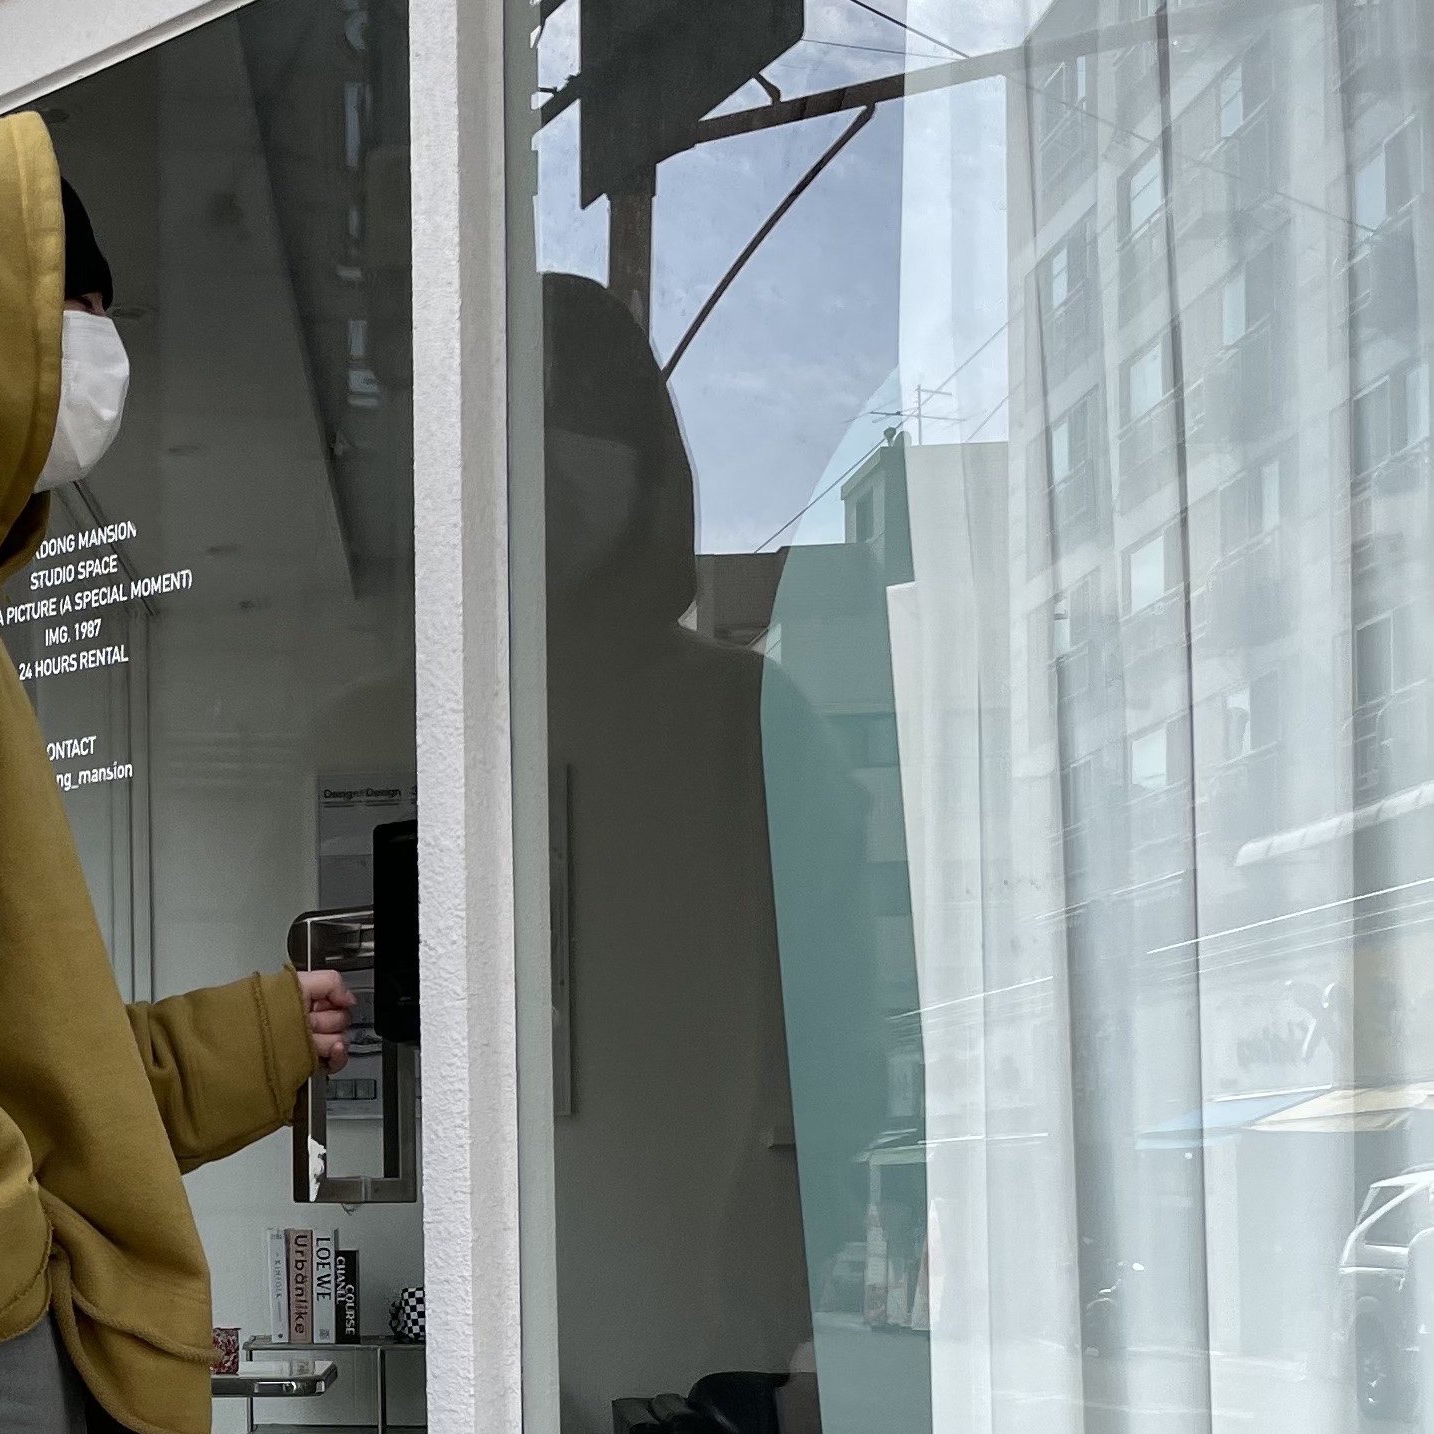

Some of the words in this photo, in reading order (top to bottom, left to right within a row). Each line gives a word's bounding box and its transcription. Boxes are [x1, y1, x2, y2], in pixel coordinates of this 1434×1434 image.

[78, 520, 137, 550] MANSION
[30, 564, 75, 590] STUDIO
[77, 554, 118, 580] SPACE
[6, 597, 57, 625] PICTURE
[59, 594, 73, 616] (A
[74, 583, 128, 610] SPECIAL
[130, 569, 193, 599] MOMENT)
[45, 625, 71, 646] IMG.
[74, 618, 102, 641] 1987
[18, 662, 33, 681] 24
[35, 653, 77, 678] HOURS
[79, 644, 129, 670] RENTAL
[316, 1237, 332, 1302] LOEWE
[345, 1284, 356, 1335] COURSE
